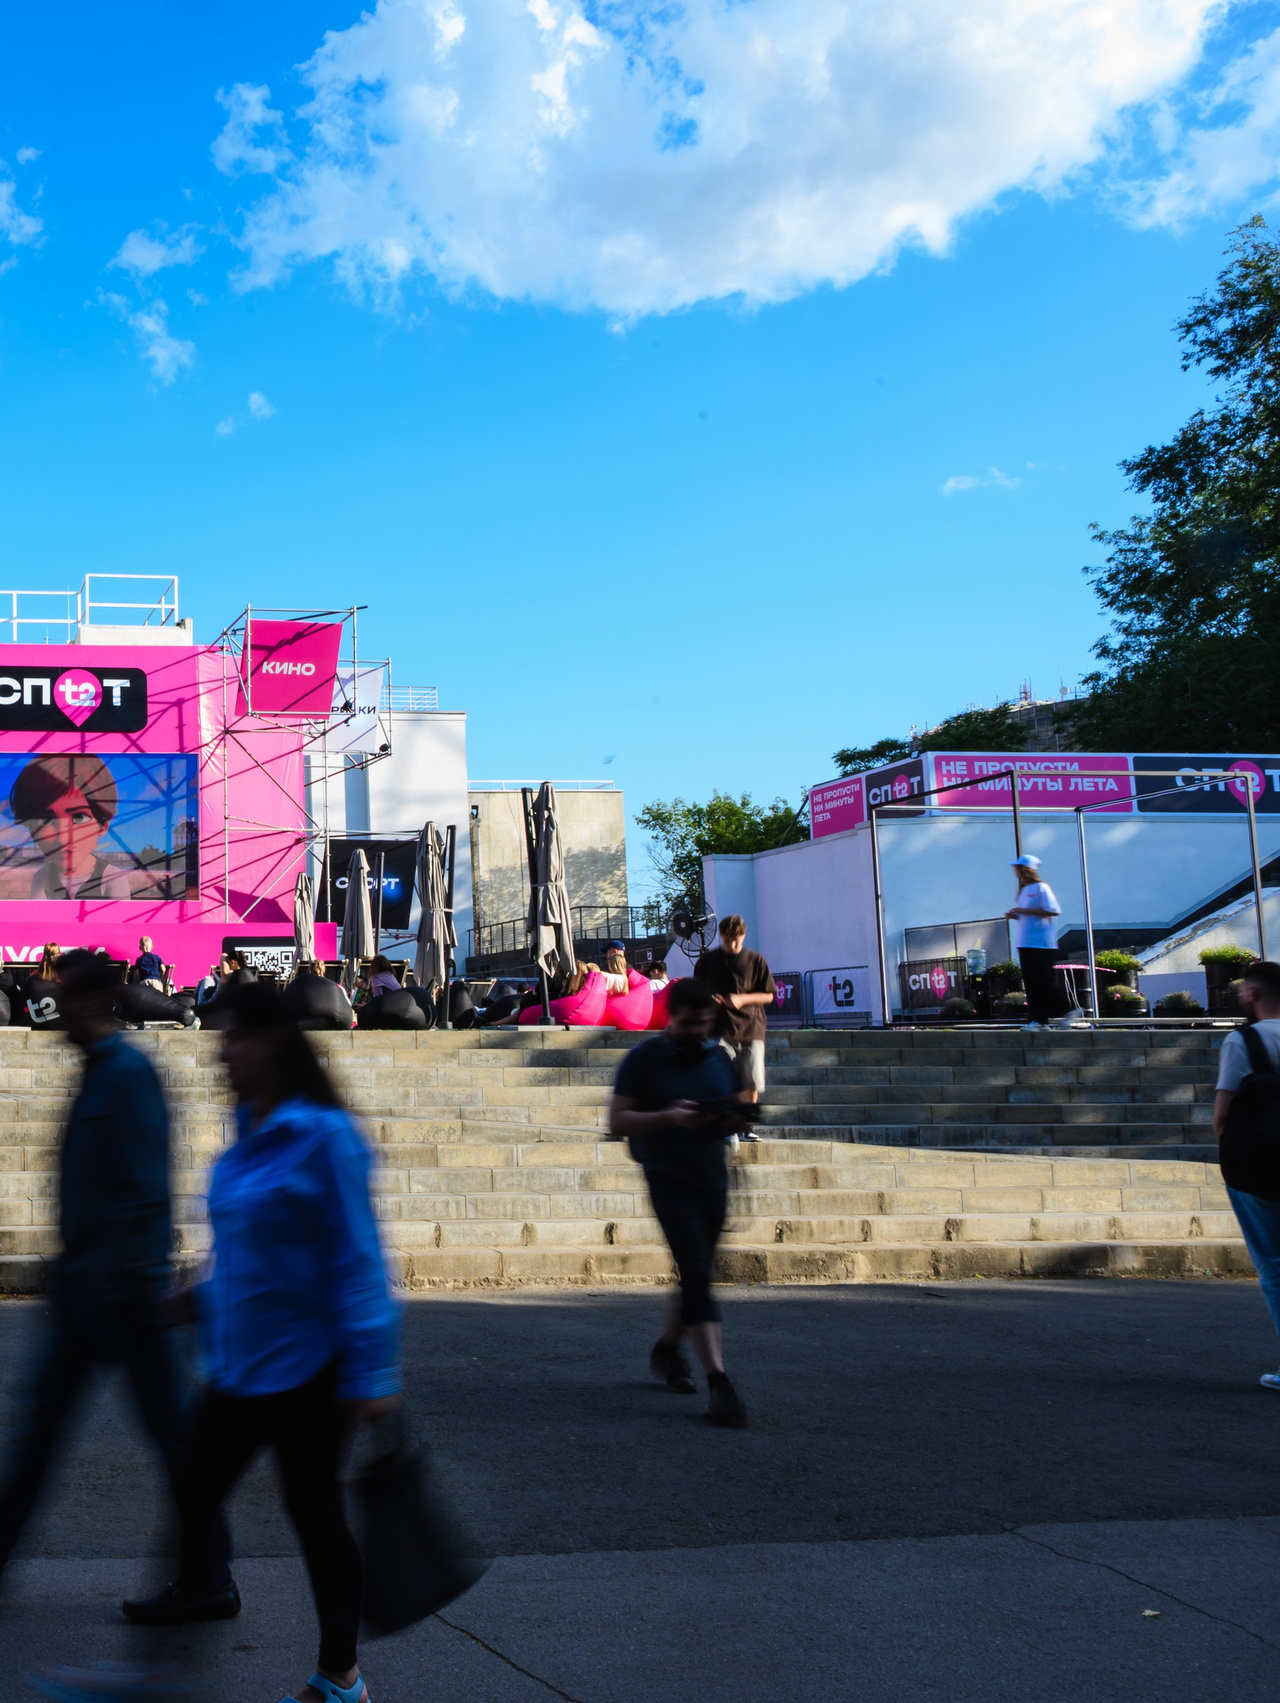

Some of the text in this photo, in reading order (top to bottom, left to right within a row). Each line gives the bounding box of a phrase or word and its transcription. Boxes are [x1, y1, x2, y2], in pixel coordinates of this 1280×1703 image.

[261, 660, 316, 676] КИНО
[941, 761, 967, 774] НЕ
[1068, 778, 1119, 791] ЛЕТА
[813, 783, 860, 803] НЕ ПРОПУСТИ
[814, 795, 854, 813] НИ МИНУТЫ
[814, 812, 831, 823] ЛЕТА
[335, 877, 400, 890] СОРТ
[828, 975, 855, 1007] t2
[23, 997, 61, 1023] t2
